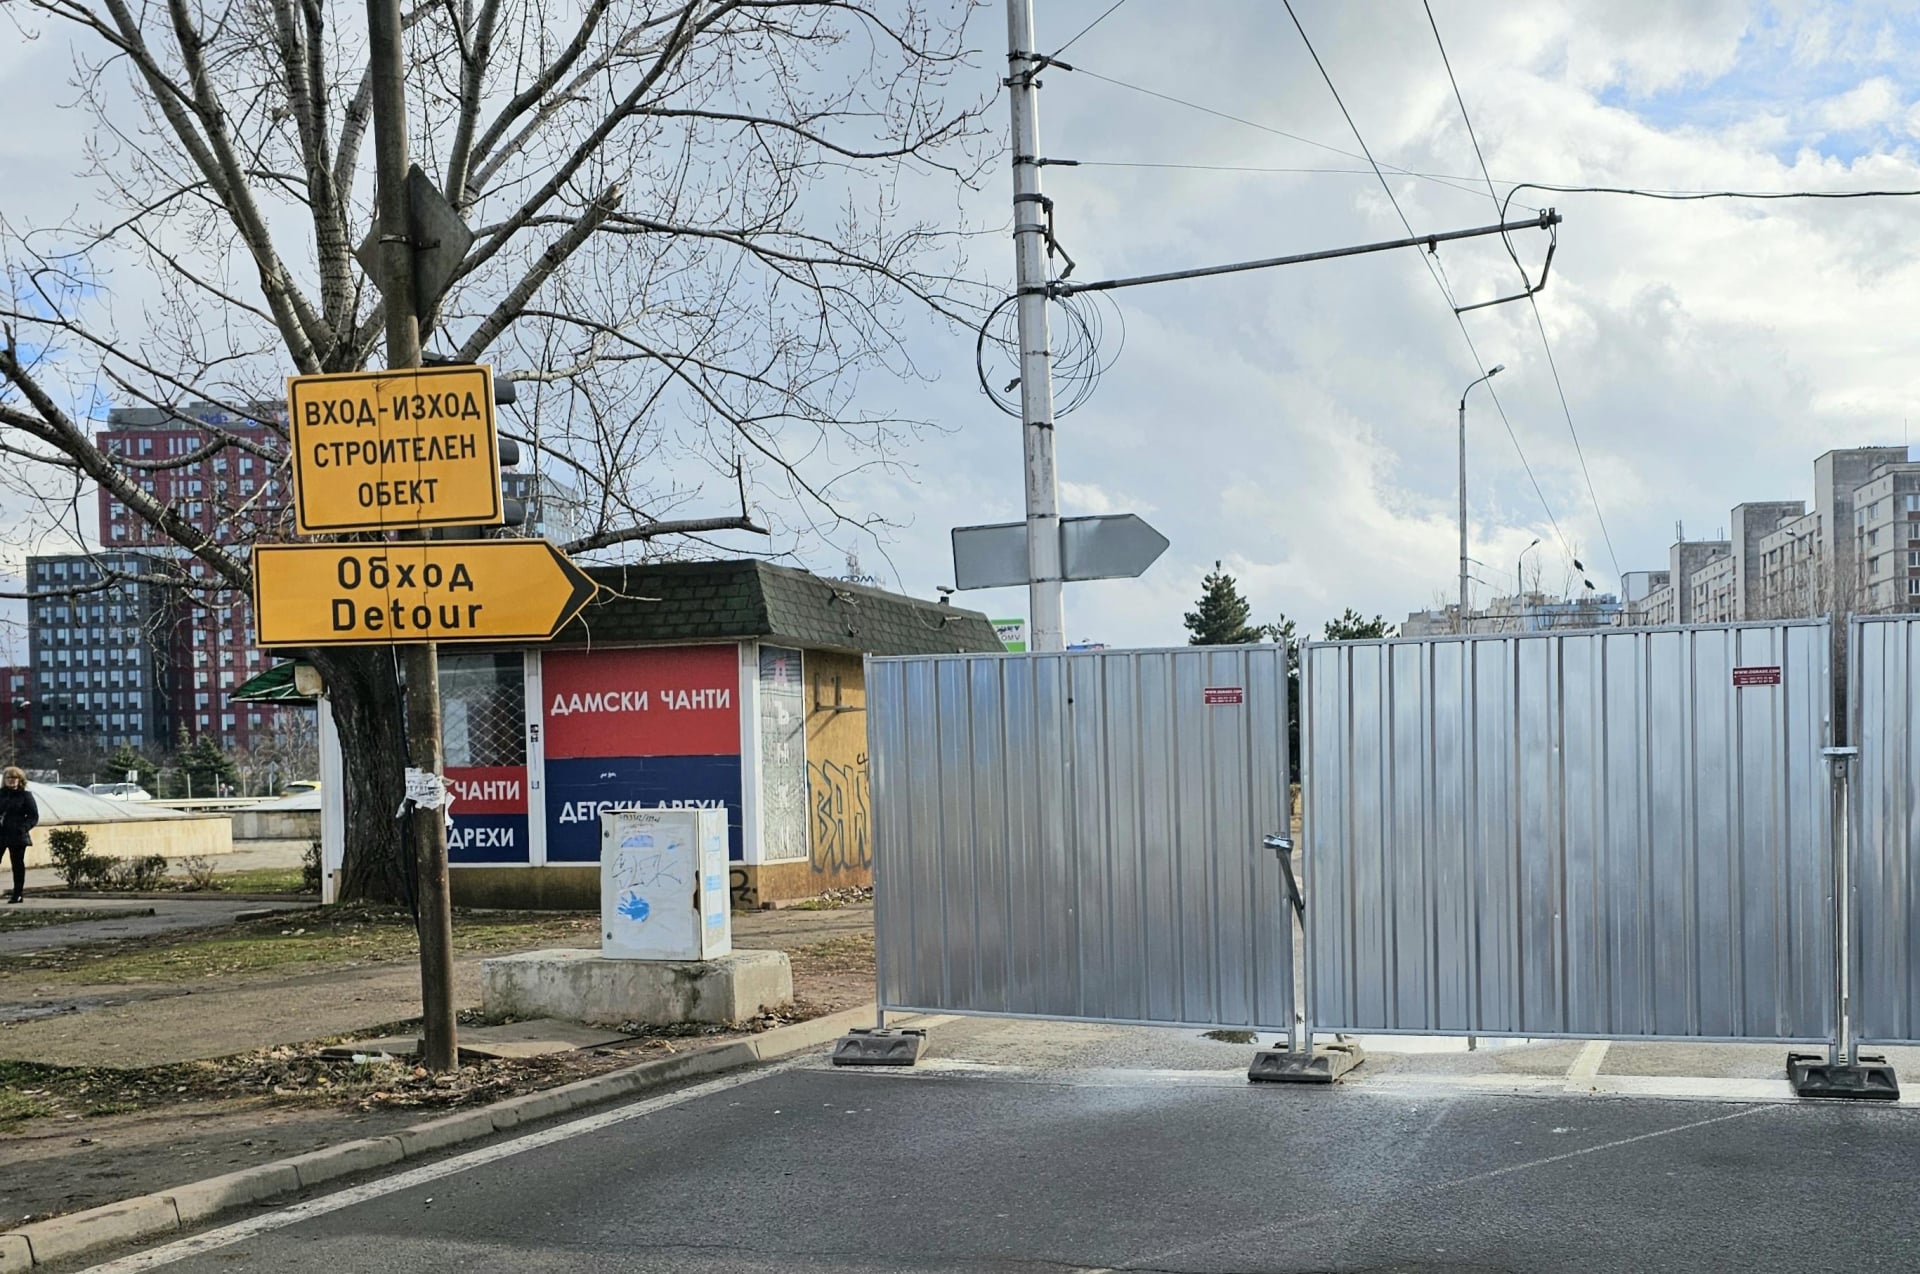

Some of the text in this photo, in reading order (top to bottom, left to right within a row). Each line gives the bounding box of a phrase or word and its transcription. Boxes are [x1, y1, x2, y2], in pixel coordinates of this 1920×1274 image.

[304, 391, 481, 427] ВХОД-ИЗХОД
[313, 433, 477, 469] СТРОИТЕЛЕН
[358, 478, 438, 508] ОБЕКТ
[337, 555, 474, 592] Обход
[331, 598, 483, 632] Detour
[551, 688, 731, 716] ДАМСКИ ЧАНТИ
[454, 780, 520, 801] ЧАНТИ
[447, 827, 515, 850] ДРЕХИ
